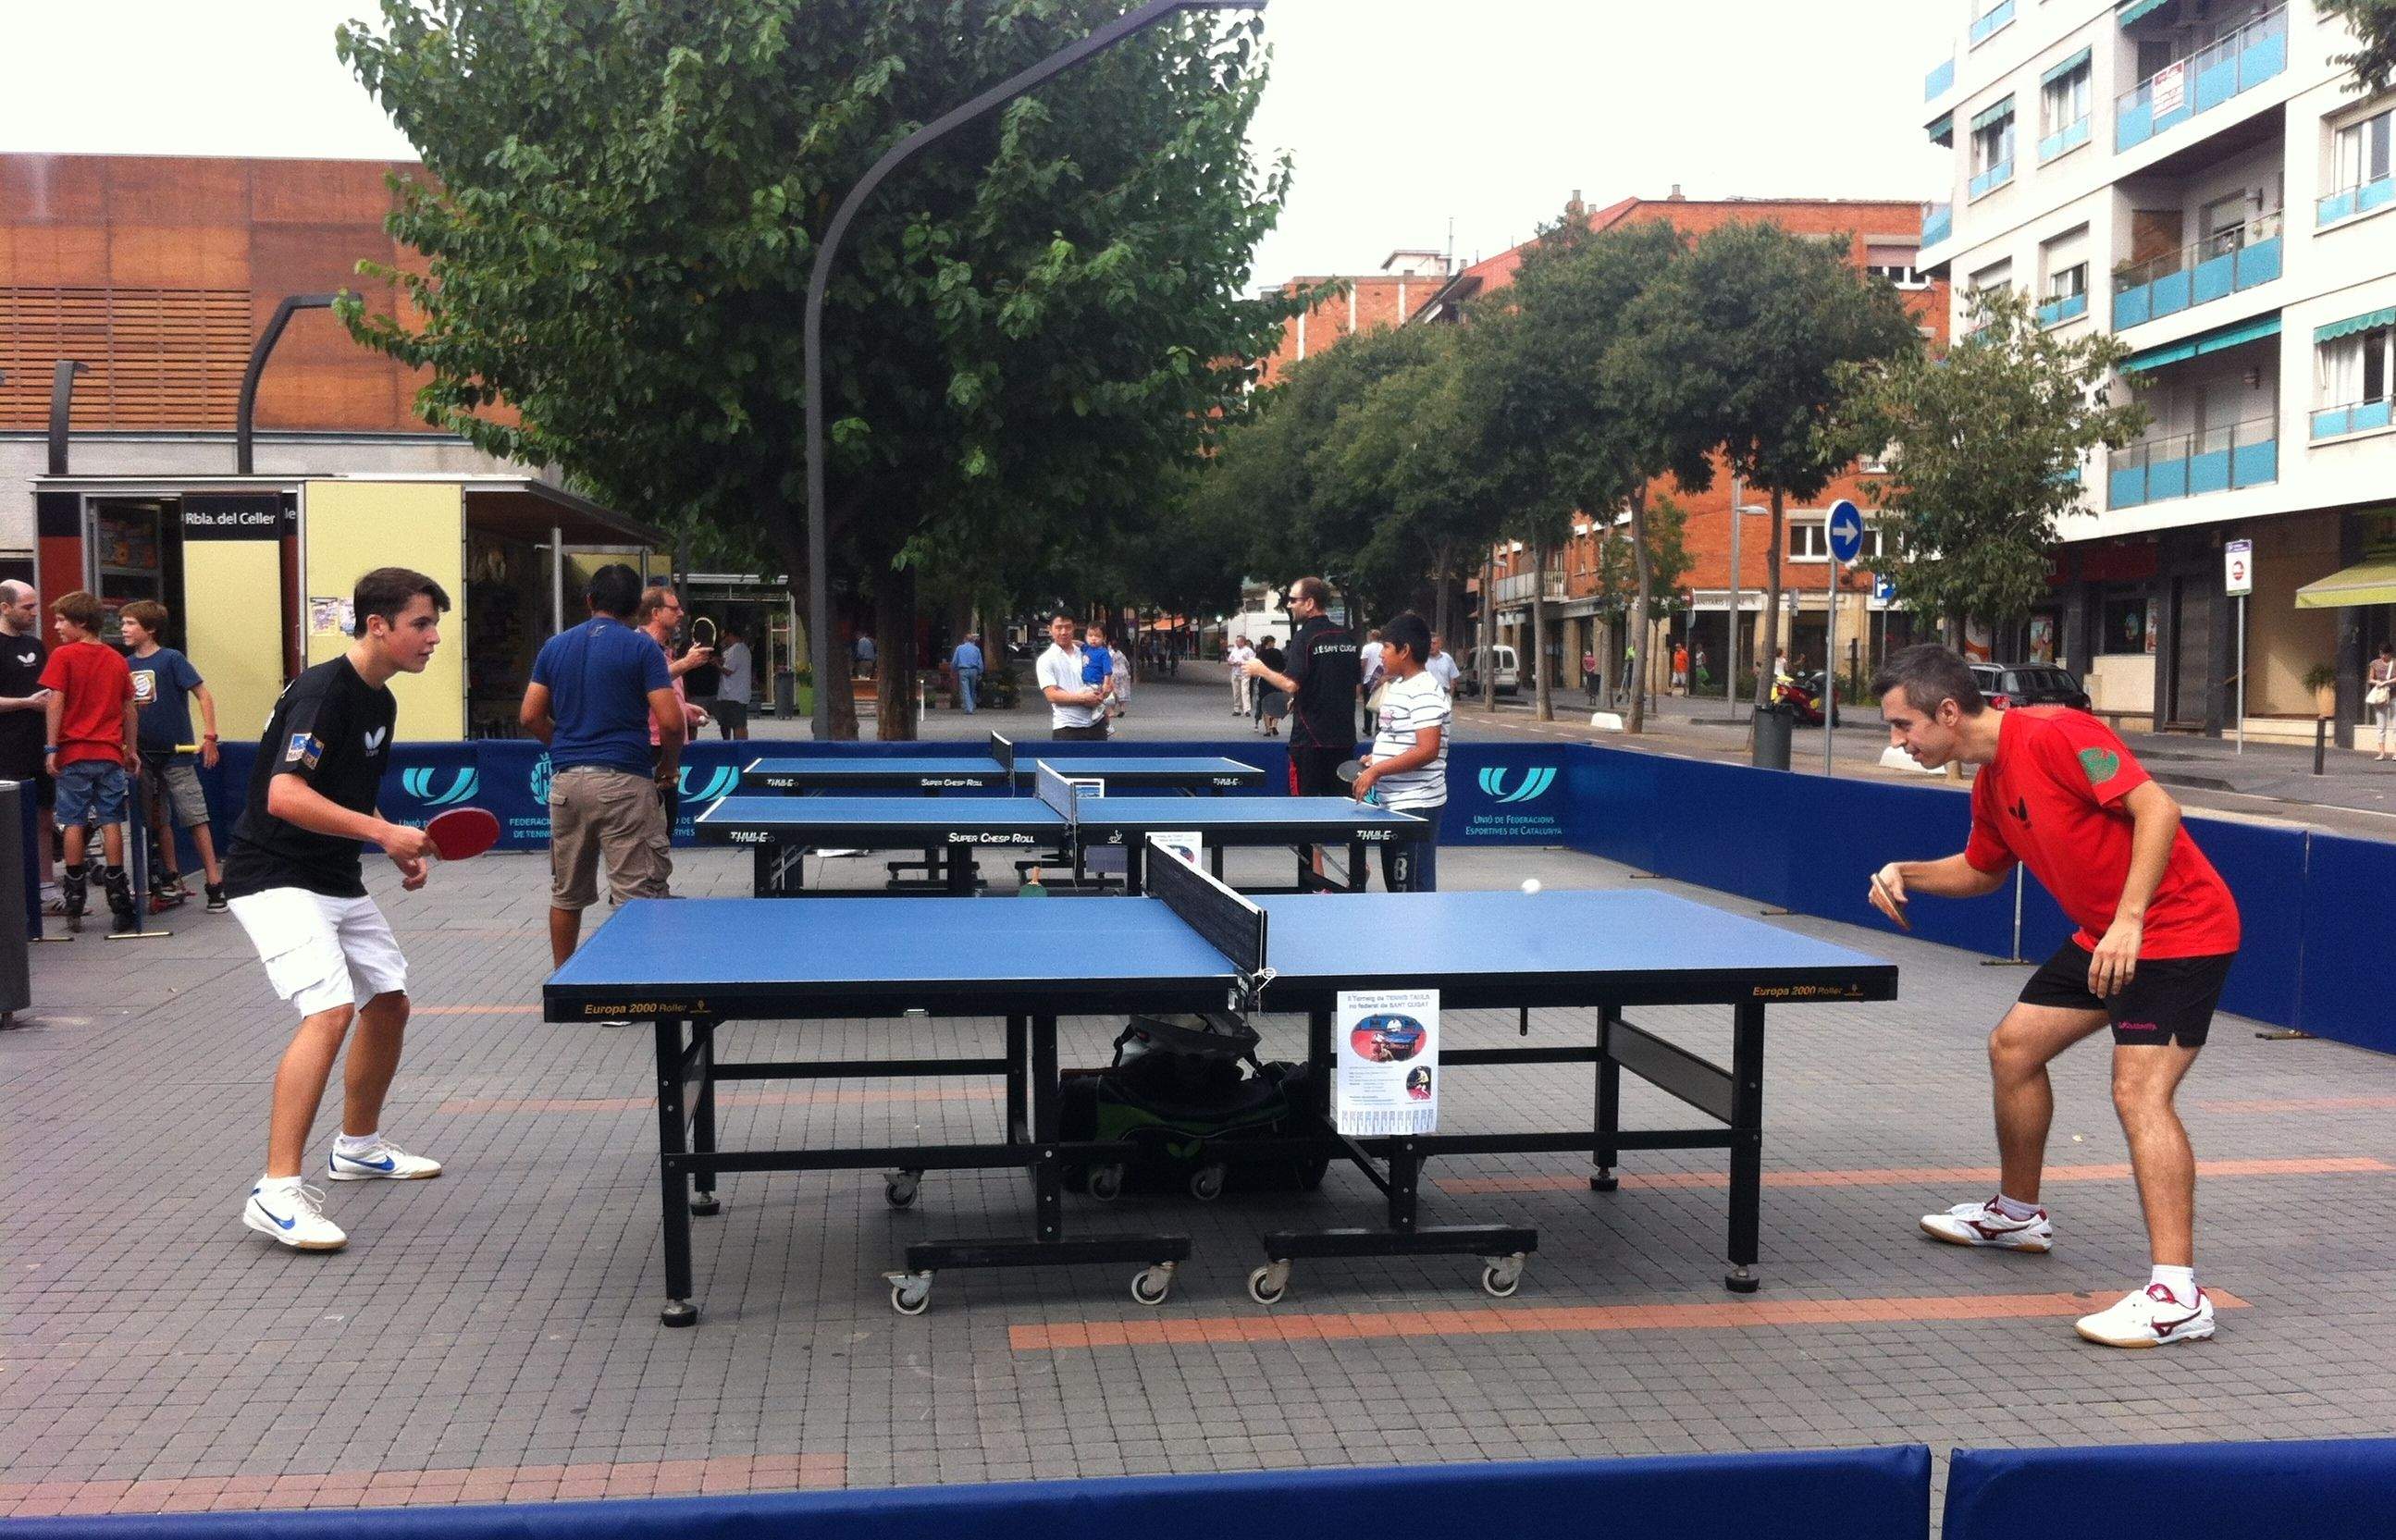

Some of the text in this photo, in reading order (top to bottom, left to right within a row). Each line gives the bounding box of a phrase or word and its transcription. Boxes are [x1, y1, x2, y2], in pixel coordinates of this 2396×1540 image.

[217, 512, 237, 524] del
[240, 512, 276, 524] Celler
[948, 832, 978, 843] SUPER
[1012, 833, 1035, 843] ROLL
[1753, 987, 1790, 997] Europa
[1791, 986, 1816, 996] 2000
[585, 1004, 626, 1015] Europa
[629, 1004, 658, 1013] 2000
